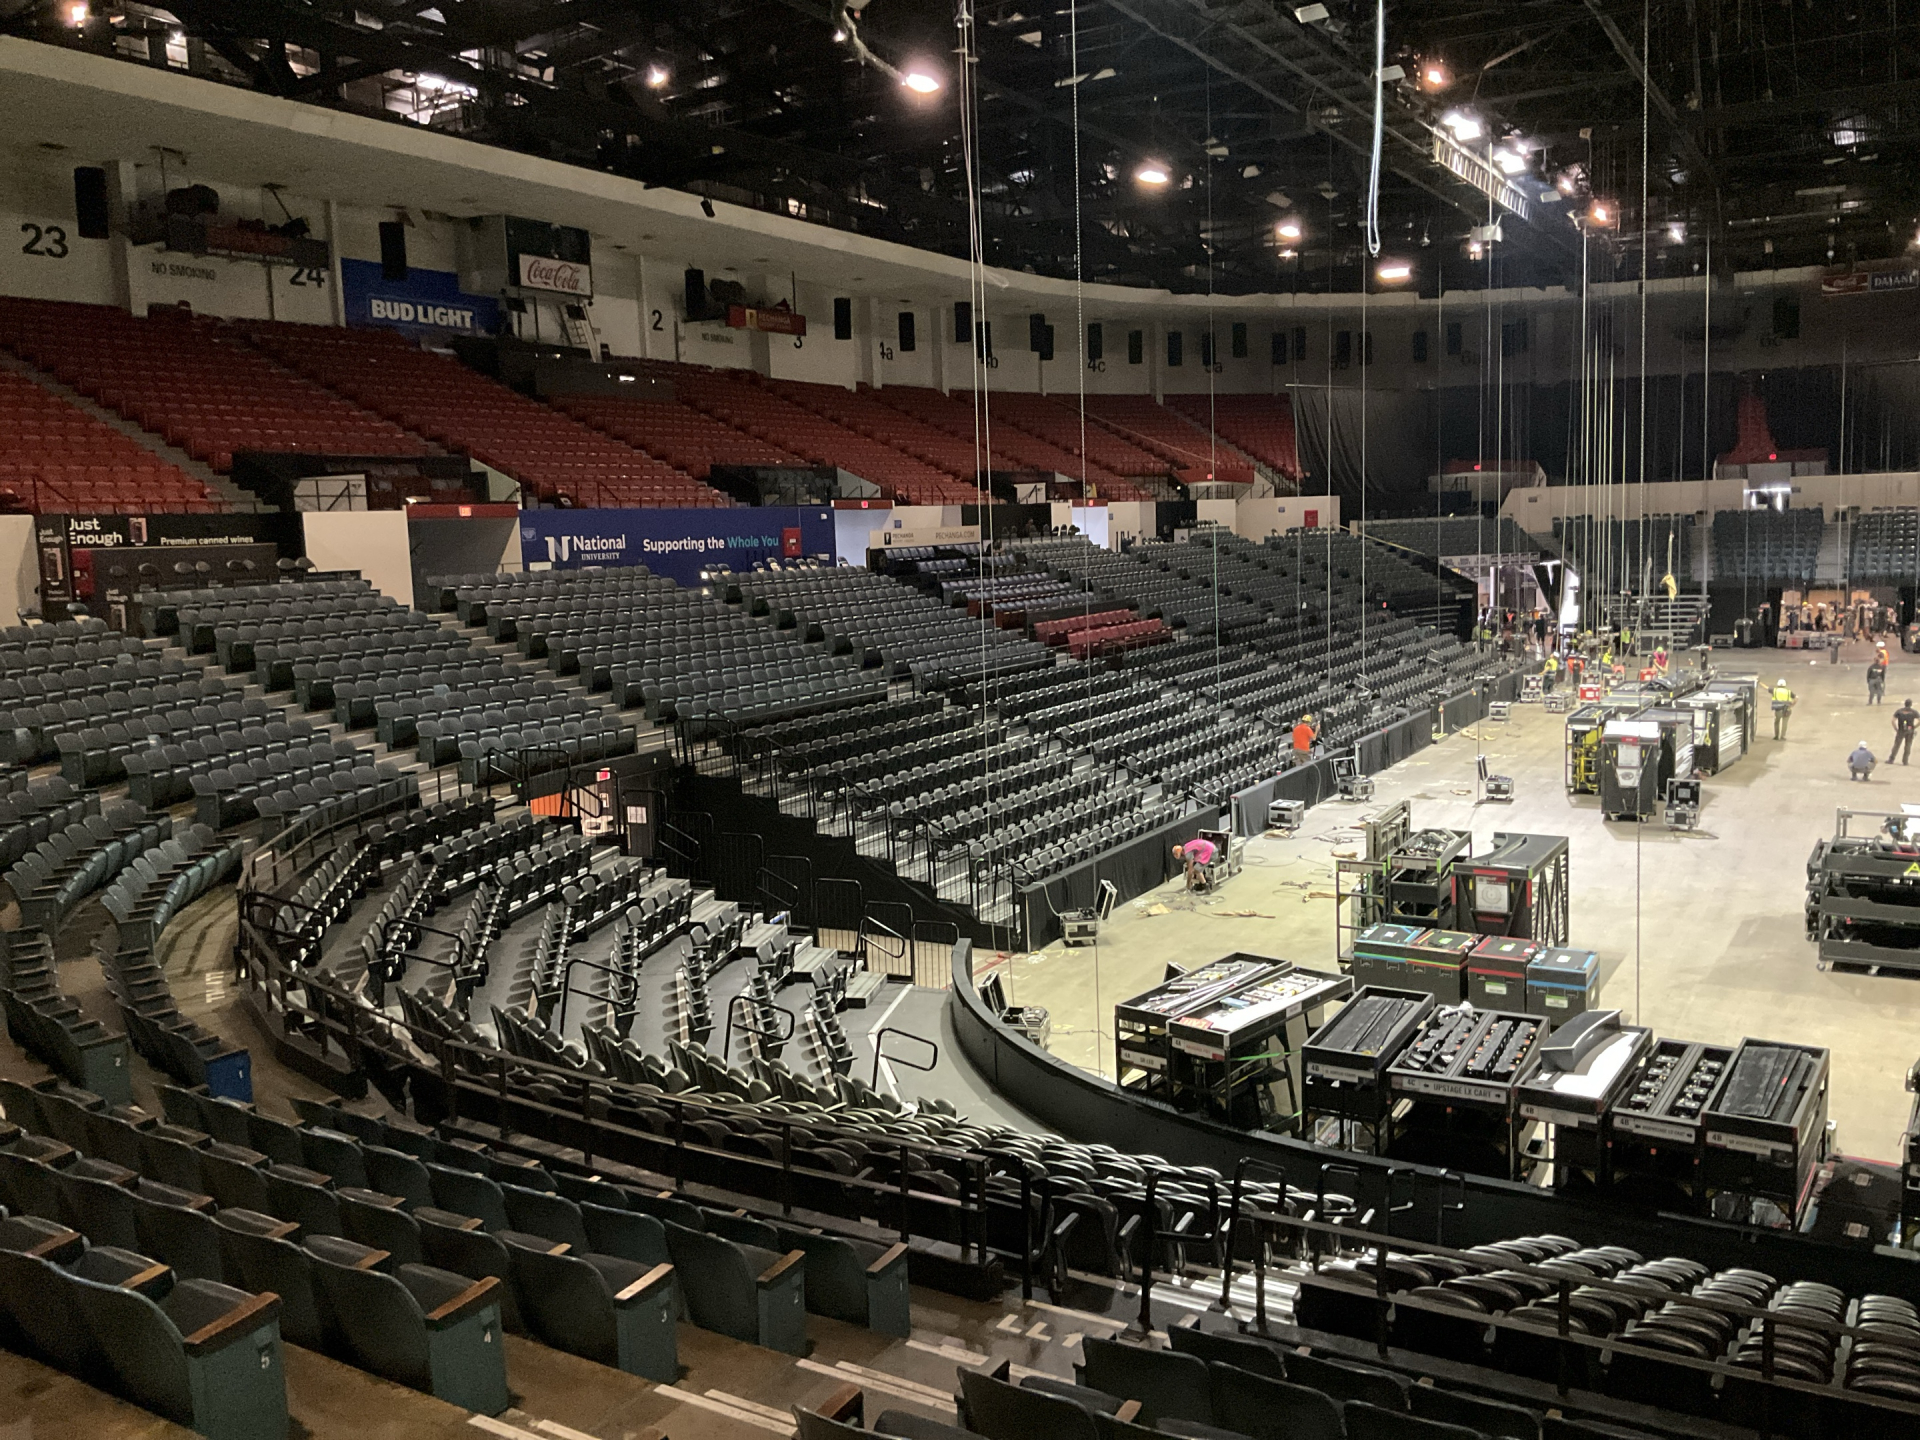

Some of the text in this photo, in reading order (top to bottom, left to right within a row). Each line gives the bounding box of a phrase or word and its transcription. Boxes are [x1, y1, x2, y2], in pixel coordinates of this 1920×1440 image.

[21, 223, 69, 258] 23
[151, 261, 216, 281] NO SMOKING
[527, 259, 581, 291] Coca-Cola
[371, 299, 473, 329] BUD LIGHT
[652, 310, 663, 331] 2
[69, 518, 101, 532] Just
[70, 532, 123, 546] Enough
[160, 535, 254, 546] Premium canned wines
[573, 534, 626, 551] National
[643, 535, 779, 554] Supporting the Whole You
[581, 552, 620, 561] UNIVERSITY
[115, 1057, 121, 1067] 2
[1433, 1083, 1463, 1095] UPSTAGE
[1464, 1088, 1472, 1096] LX
[1473, 1088, 1491, 1099] CART
[483, 1330, 491, 1343] 4
[261, 1354, 270, 1369] 5
